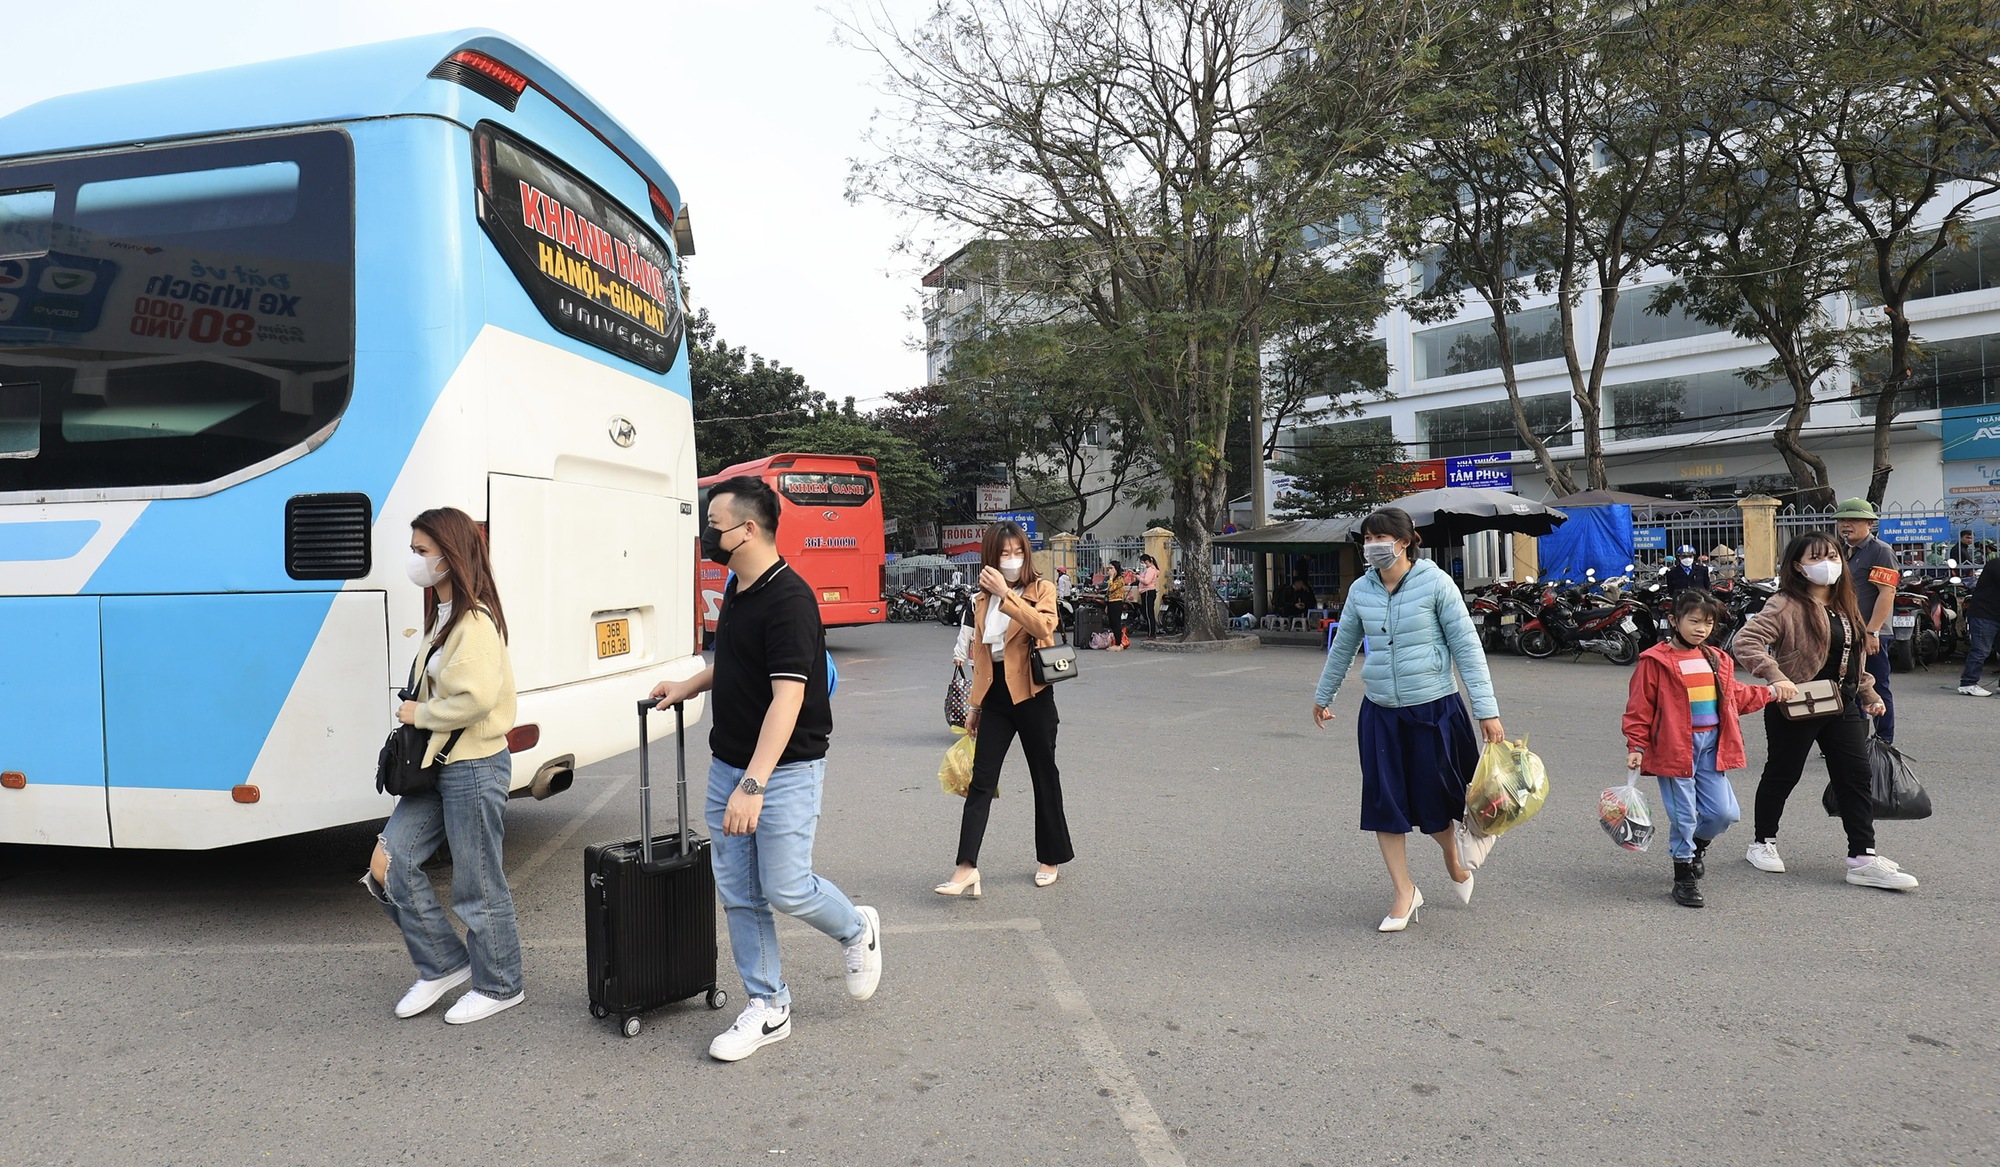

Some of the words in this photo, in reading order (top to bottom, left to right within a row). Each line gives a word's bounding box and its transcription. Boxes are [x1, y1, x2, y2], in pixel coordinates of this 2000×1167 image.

[519, 180, 615, 273] KHANH
[559, 299, 665, 359] UNIVERSE
[1450, 469, 1473, 482] TÂM
[1716, 464, 1724, 476] B
[831, 483, 865, 495] OANH
[1022, 522, 1028, 531] 3
[606, 622, 621, 638] 36B
[601, 637, 627, 655] 018.38
